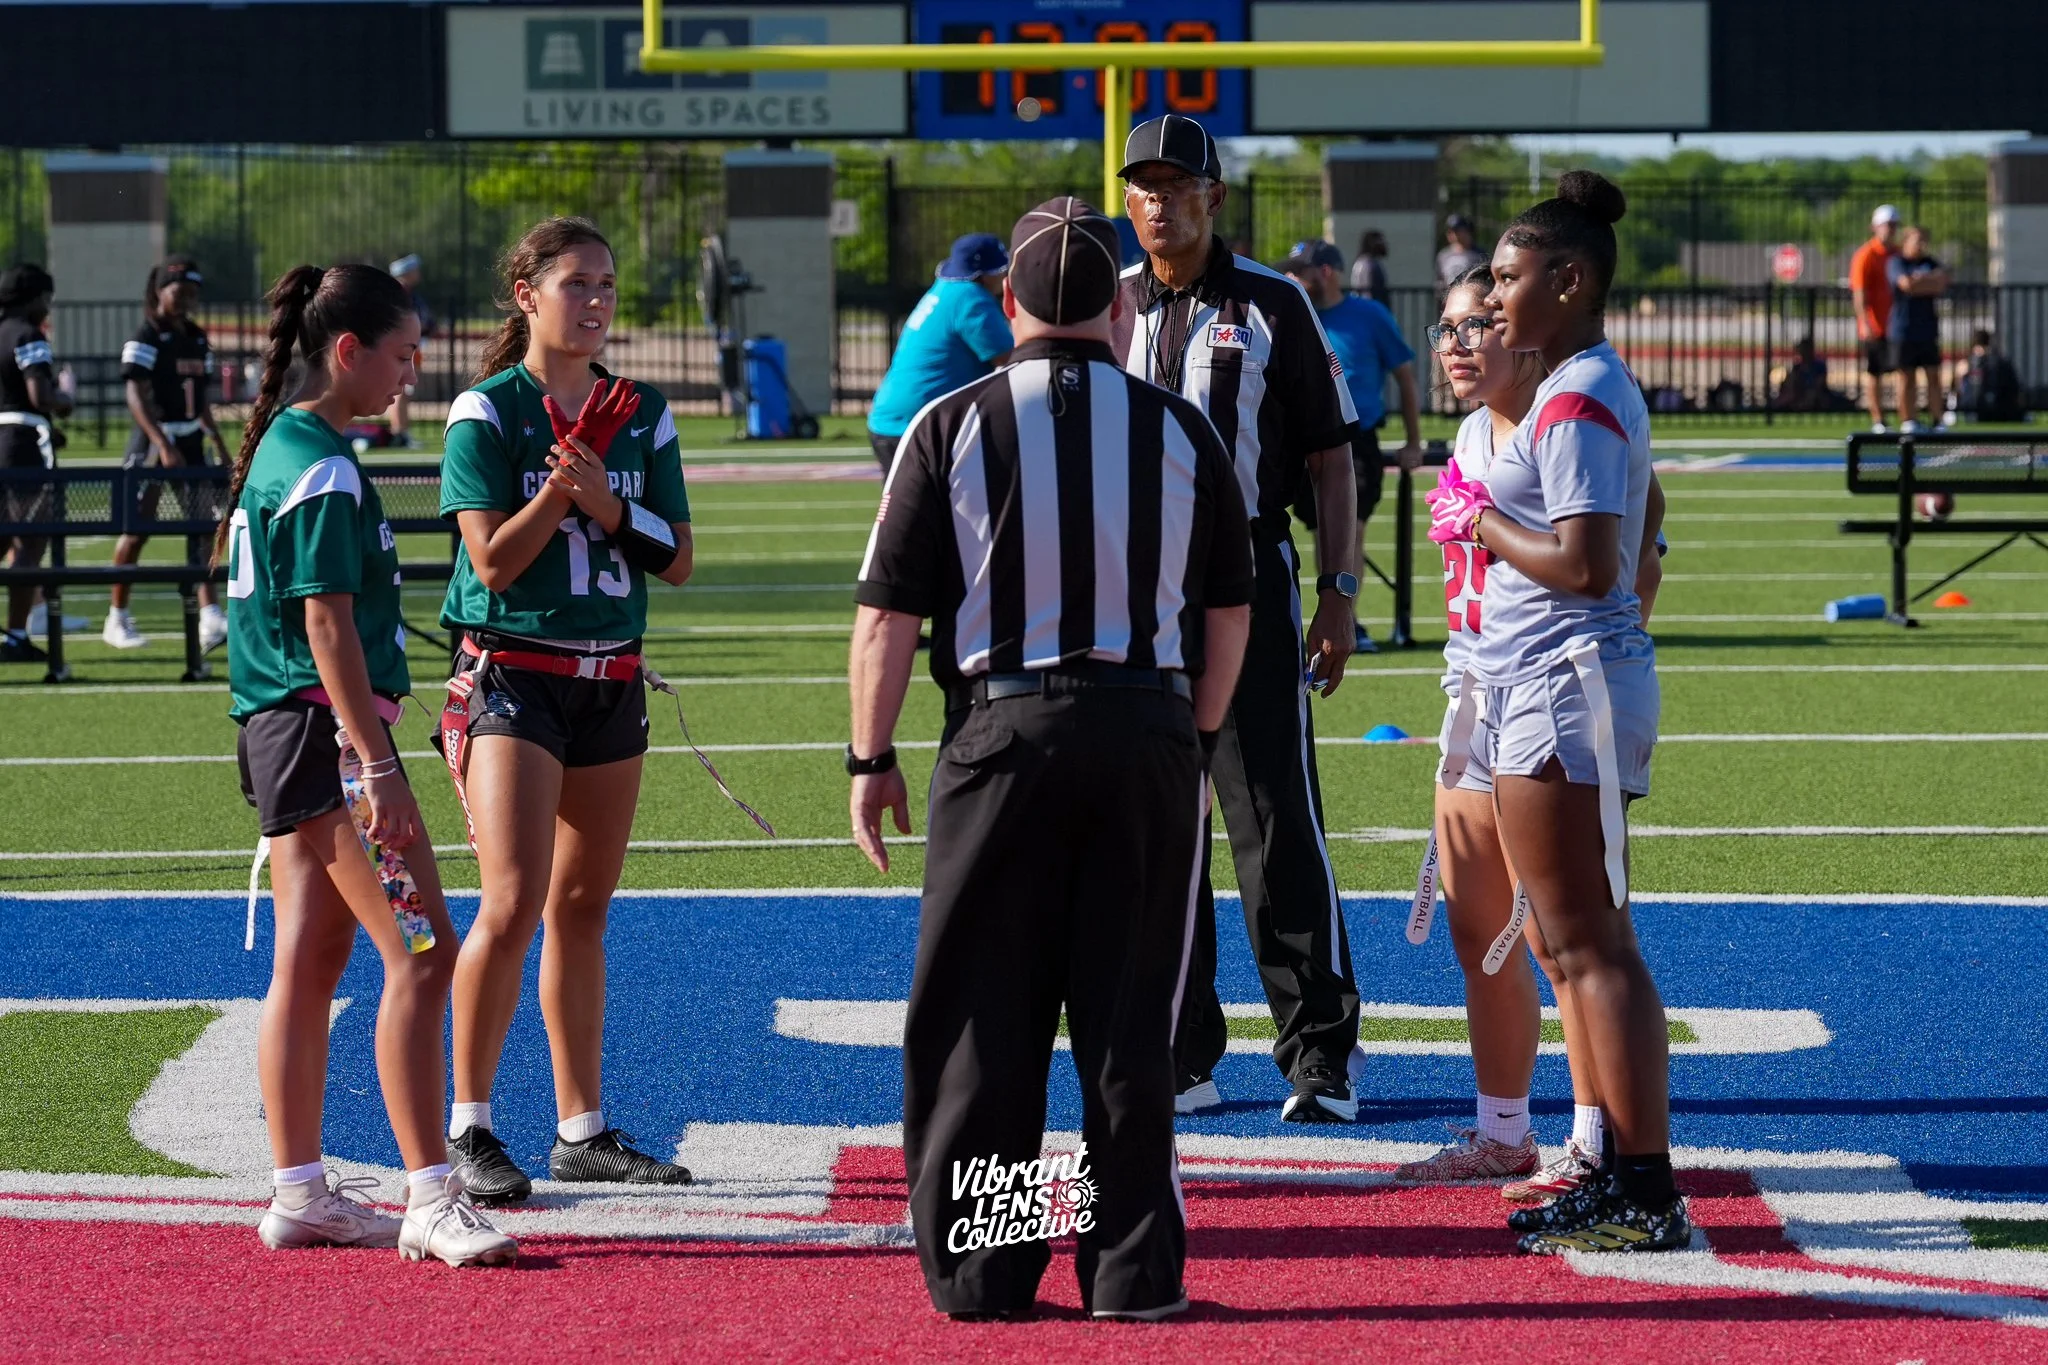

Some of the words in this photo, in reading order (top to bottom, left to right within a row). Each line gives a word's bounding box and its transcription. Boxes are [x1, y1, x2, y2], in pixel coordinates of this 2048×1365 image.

[978, 21, 1217, 112] 12:00
[523, 98, 665, 128] LIVING
[685, 96, 831, 127] SPACES
[559, 516, 632, 598] 13
